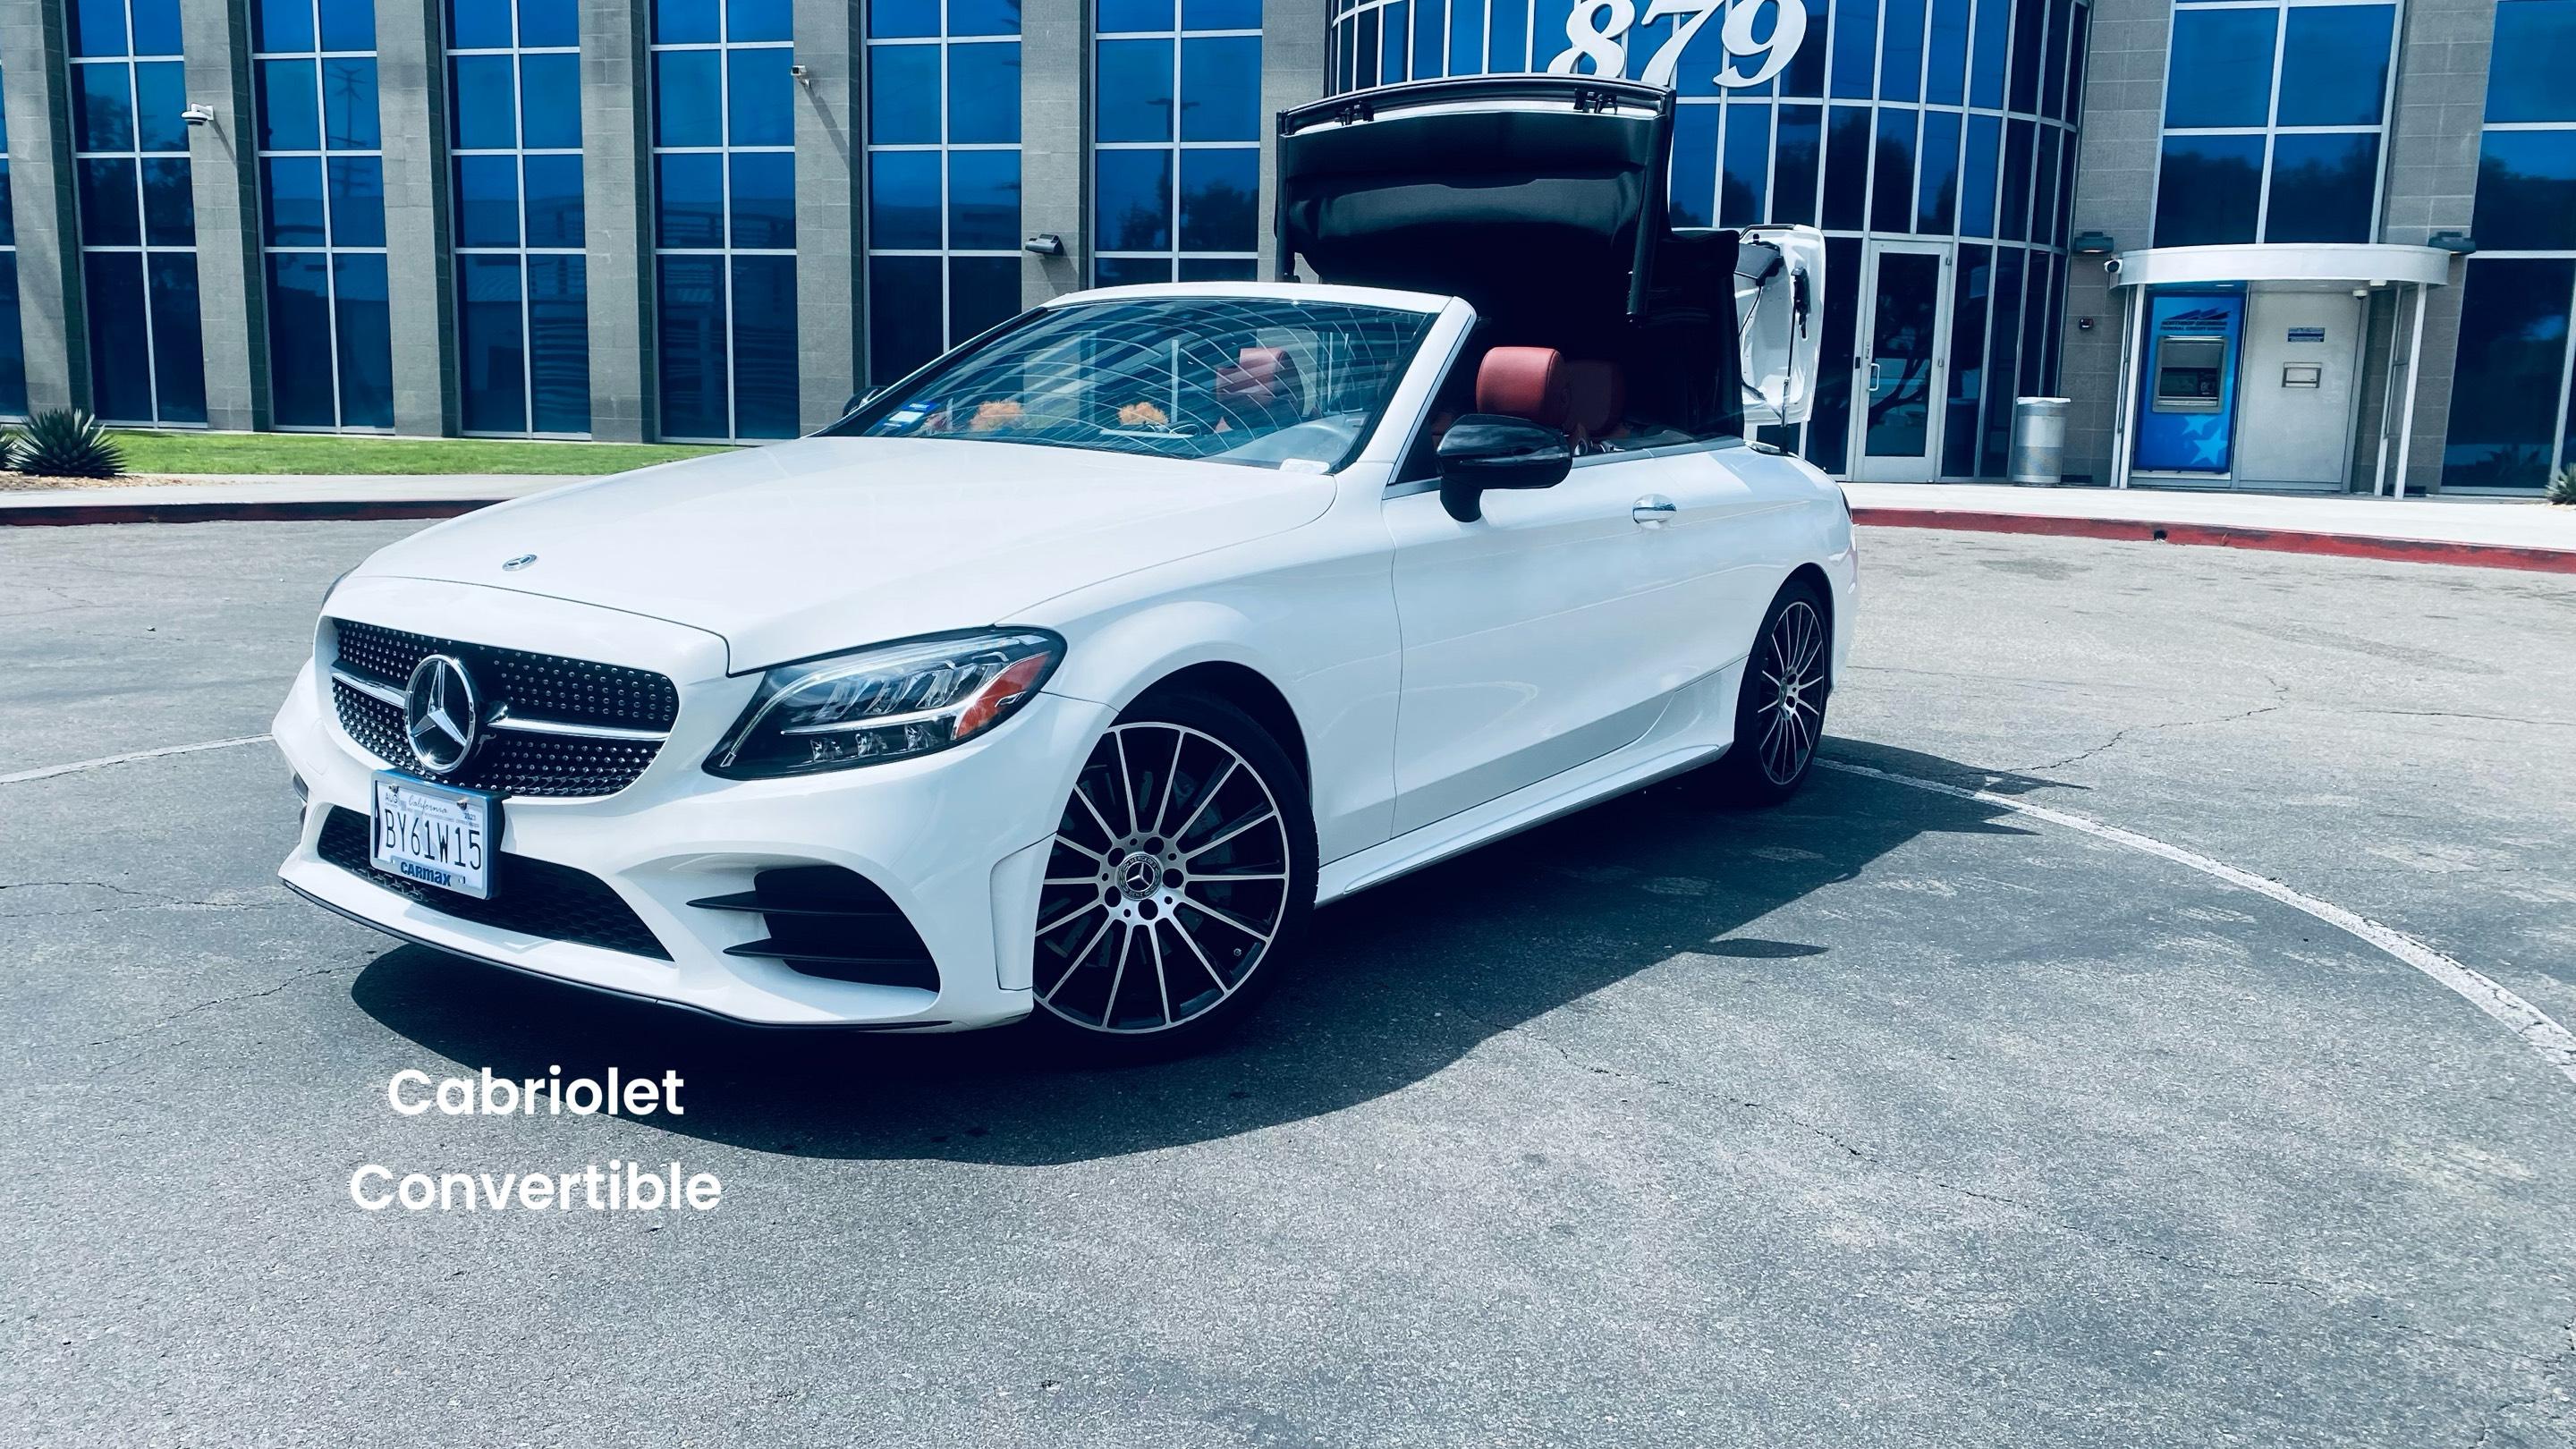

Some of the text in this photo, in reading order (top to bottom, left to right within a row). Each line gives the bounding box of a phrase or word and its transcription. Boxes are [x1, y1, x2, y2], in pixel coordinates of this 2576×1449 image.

[1547, 0, 1807, 88] 879
[385, 792, 398, 804] AUG
[408, 794, 448, 815] California
[385, 809, 481, 870] BY61W15
